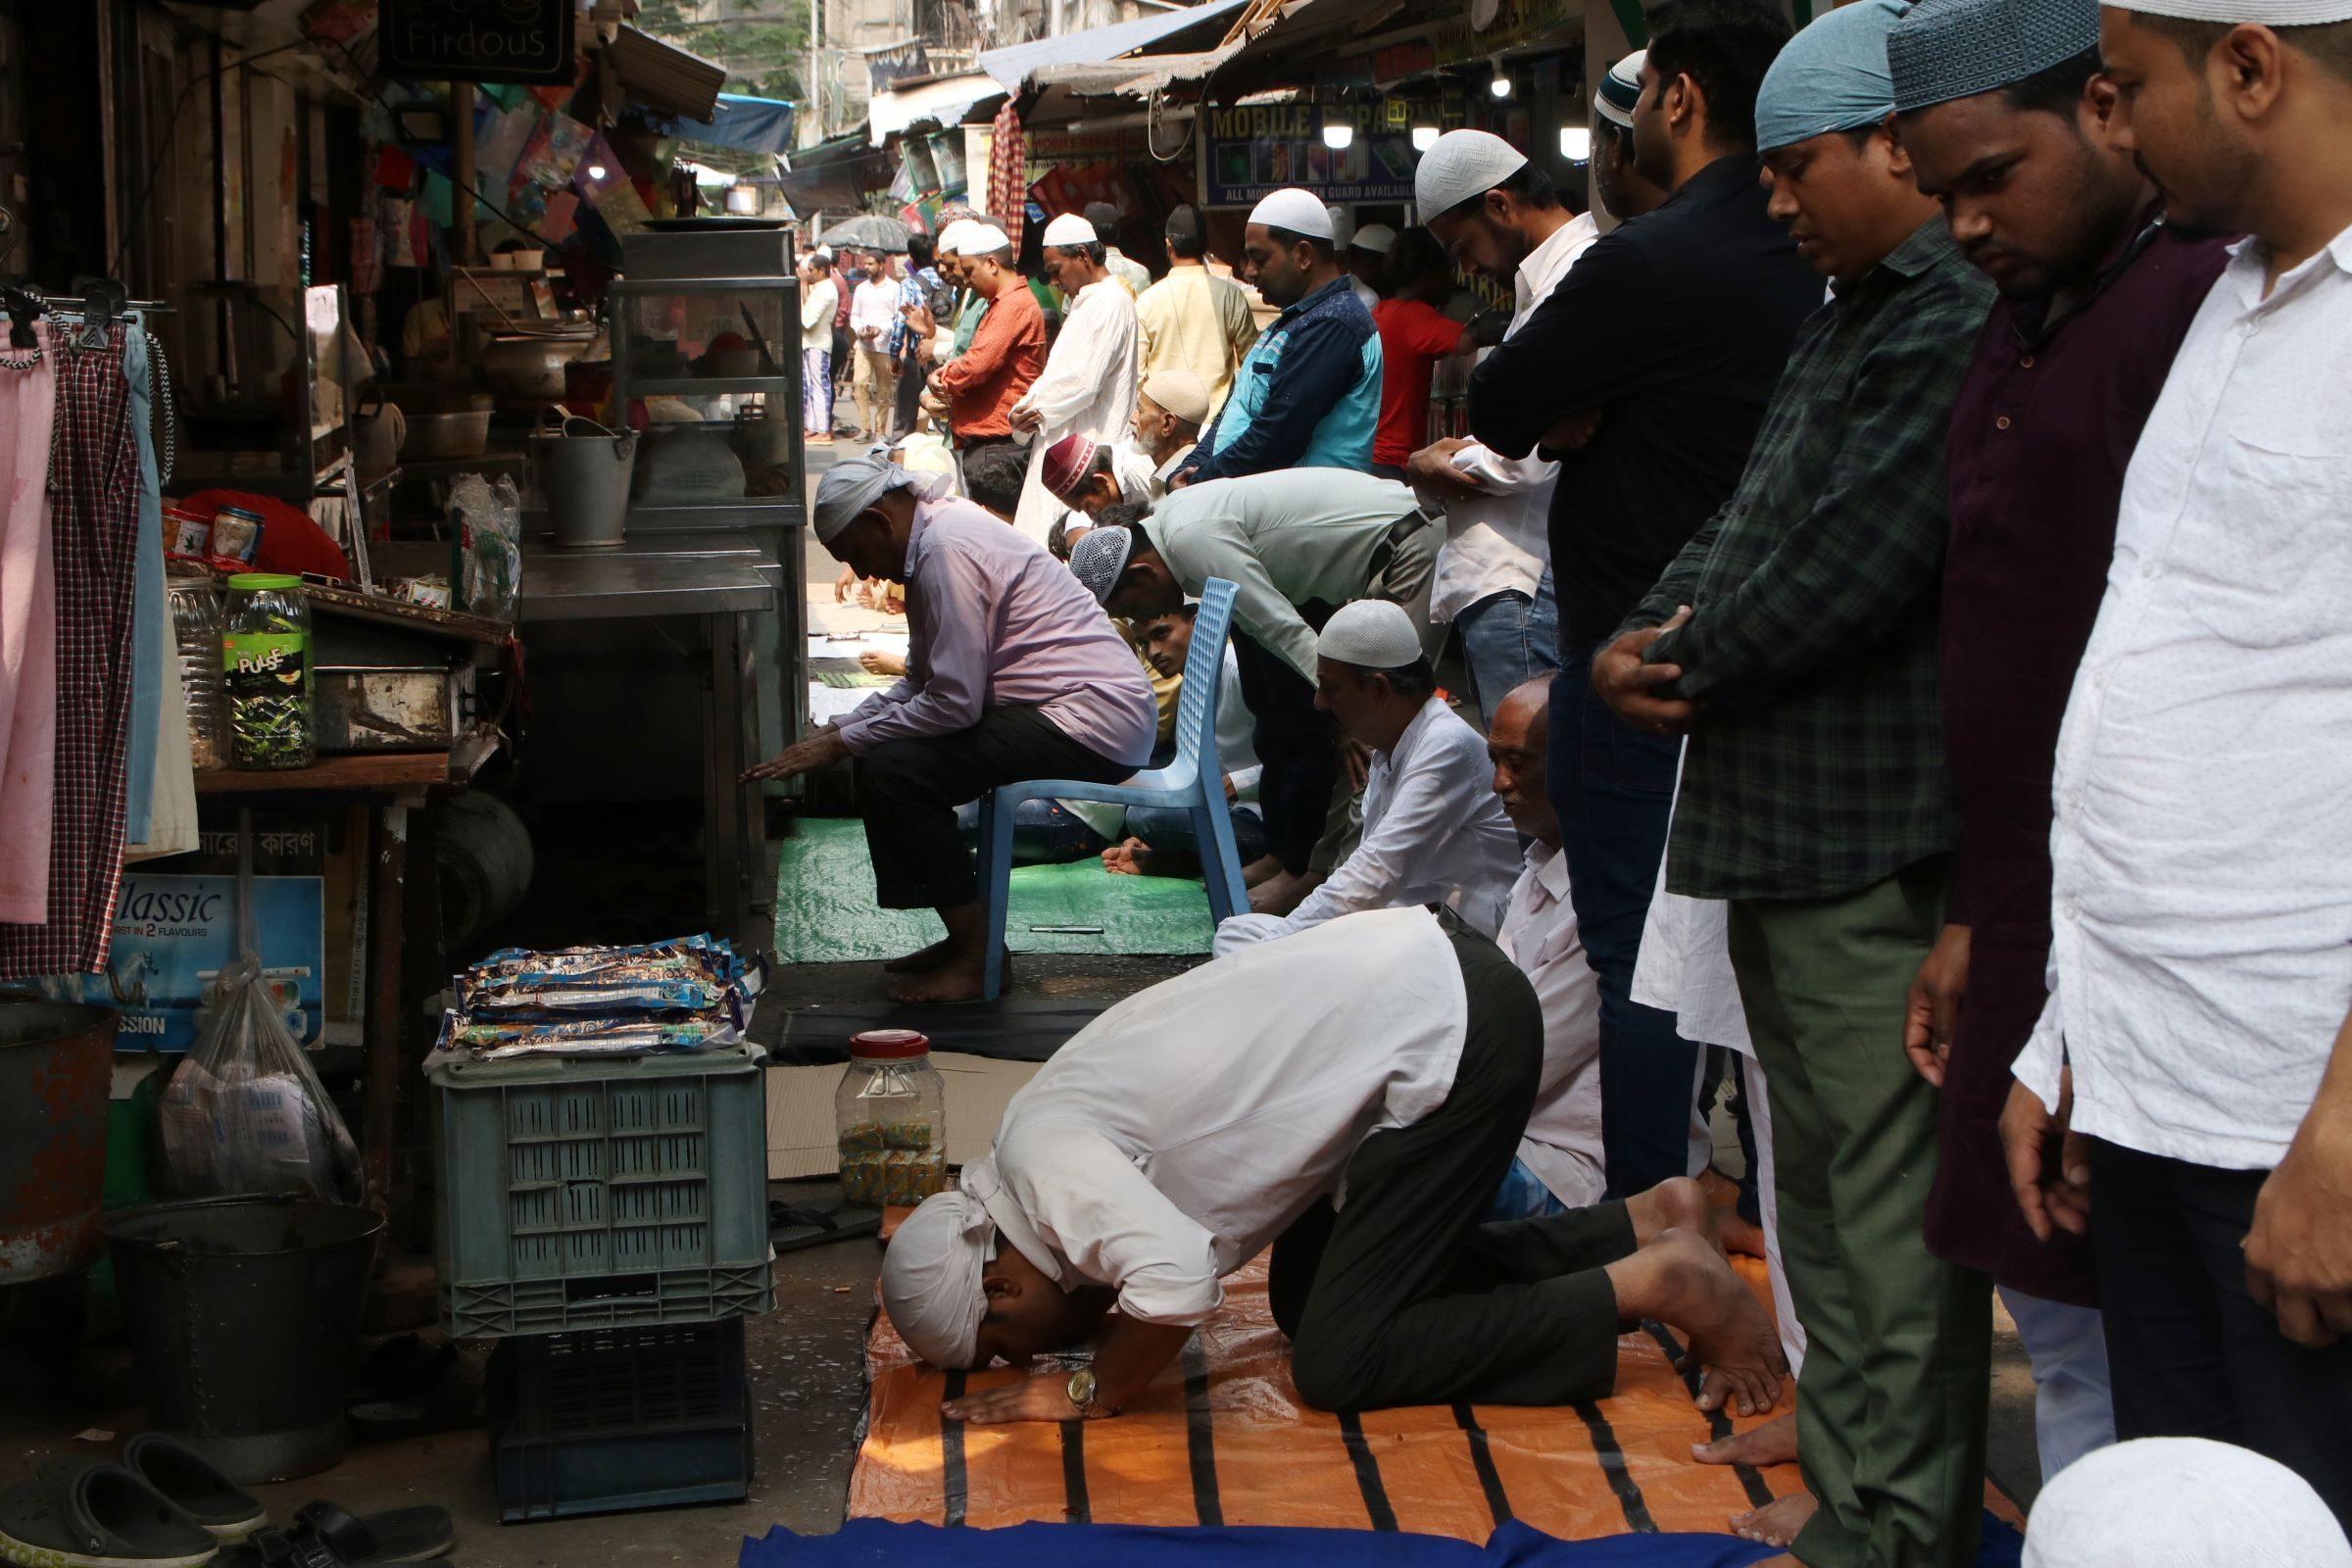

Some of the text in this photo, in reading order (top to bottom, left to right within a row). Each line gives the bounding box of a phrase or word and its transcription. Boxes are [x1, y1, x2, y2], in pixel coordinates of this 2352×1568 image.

[408, 17, 546, 60] Firdous
[1211, 104, 1312, 138] MOBILE
[1226, 189, 1246, 202] ALL
[1328, 186, 1362, 198] GUARD
[238, 648, 284, 675] PULSE
[259, 830, 316, 858] কারণ
[116, 880, 222, 923] lassic
[115, 923, 209, 937] RST IN 2 FLAVOURS
[118, 1015, 166, 1035] SSION
